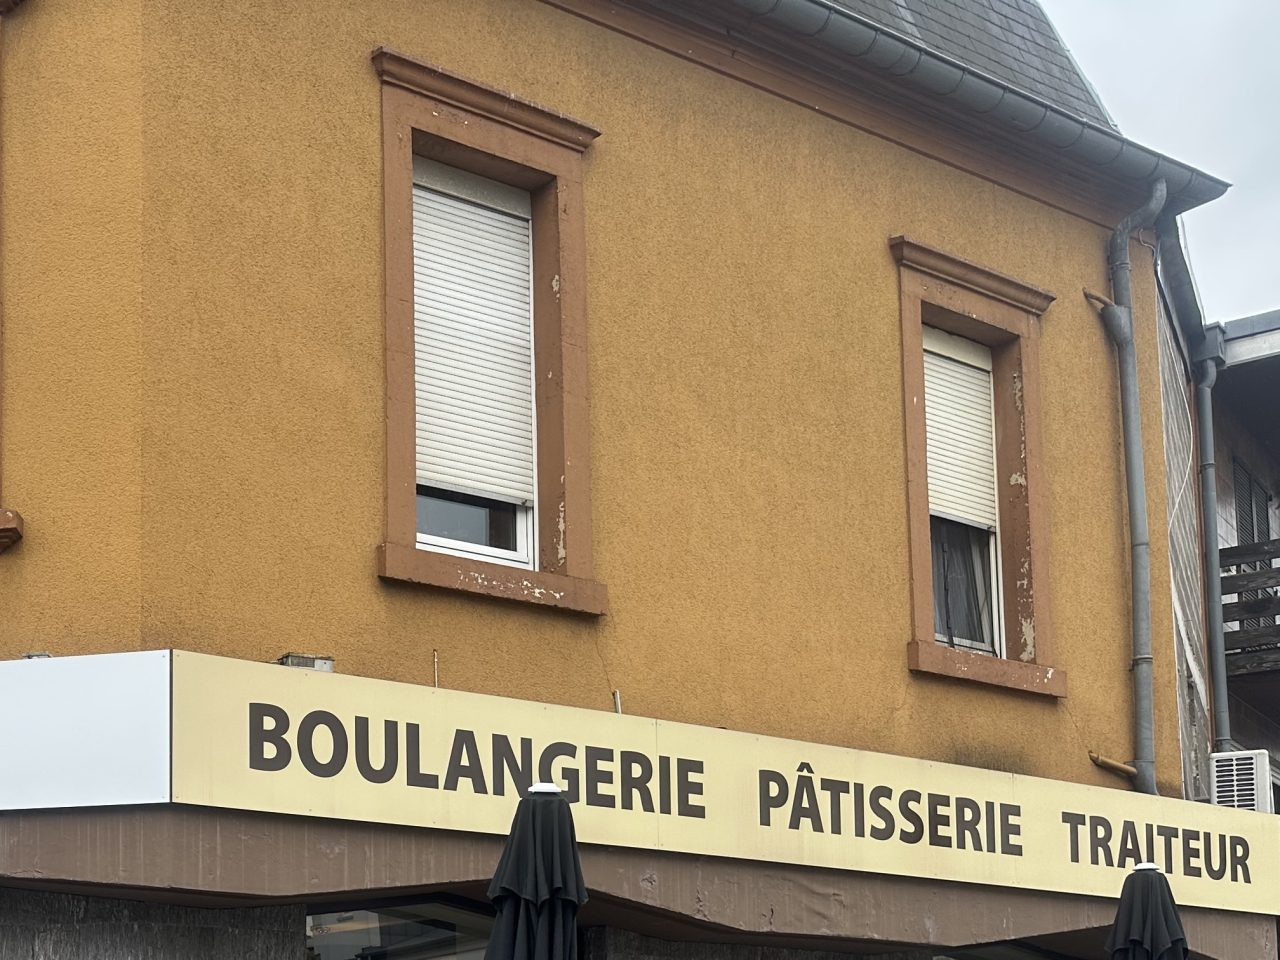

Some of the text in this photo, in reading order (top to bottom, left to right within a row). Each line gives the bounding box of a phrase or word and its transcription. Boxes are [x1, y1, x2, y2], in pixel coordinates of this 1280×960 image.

[249, 702, 1252, 884] BOULANGERIE PÂTISSERIE TRAITEUR
